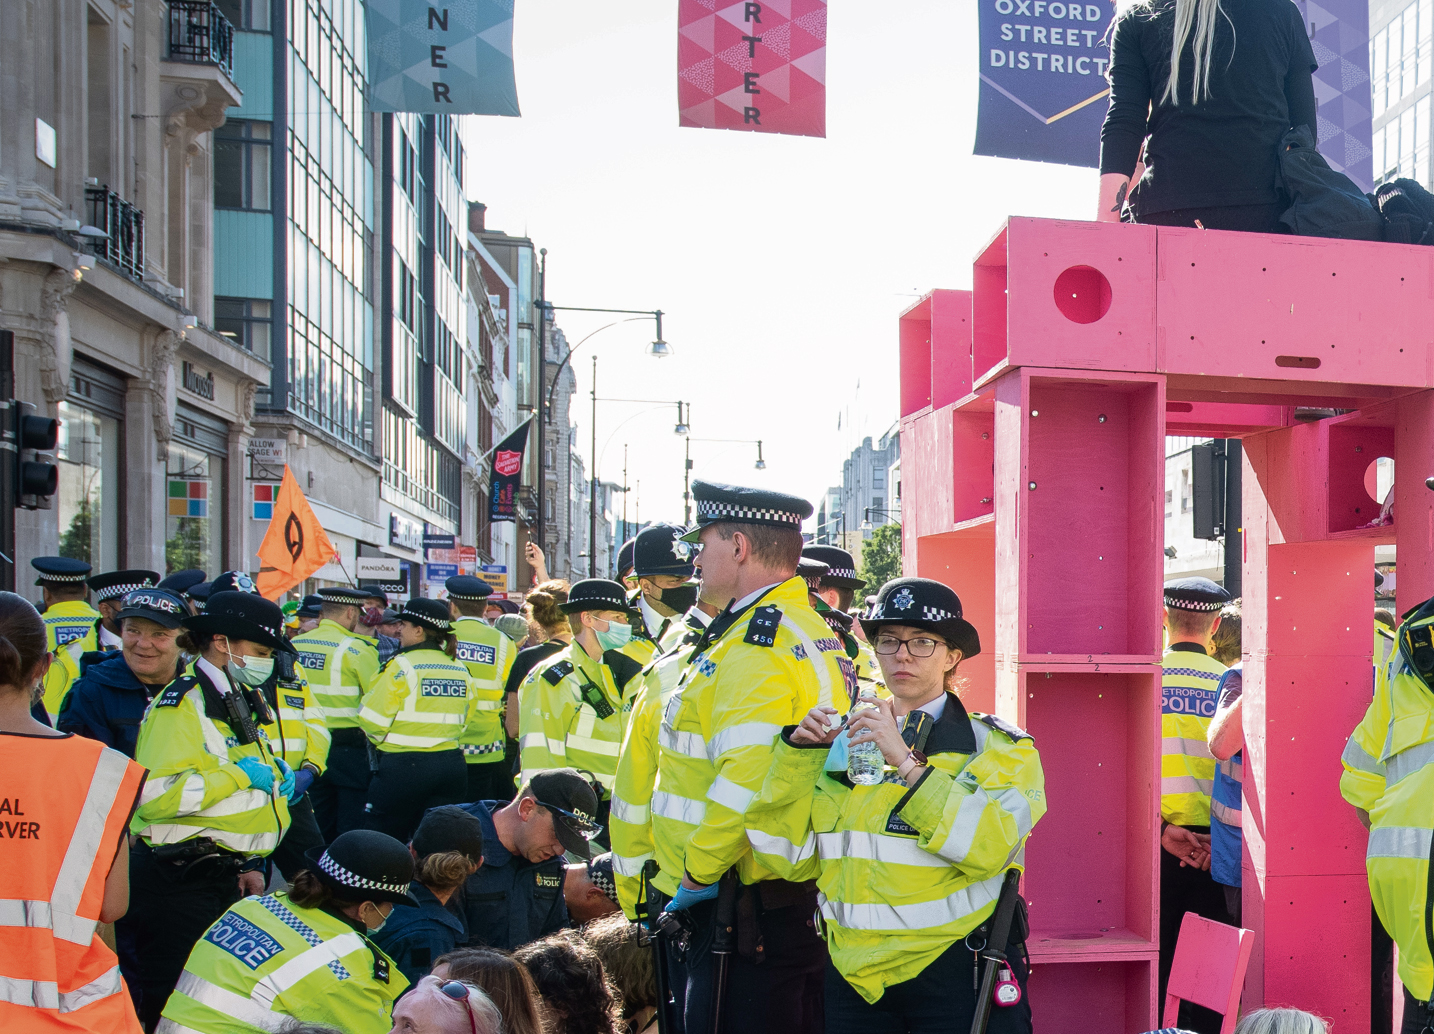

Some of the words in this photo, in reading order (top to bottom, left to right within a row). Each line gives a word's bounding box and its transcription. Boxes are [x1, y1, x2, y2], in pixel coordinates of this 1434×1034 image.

[994, 0, 1101, 22] OXFORD
[1000, 24, 1098, 49] STREET
[990, 49, 1110, 77] DISTRICT
[183, 361, 214, 401] Microsoft
[248, 440, 275, 449] ALLOW
[133, 595, 175, 614] POLICE
[756, 619, 772, 627] CE
[58, 633, 87, 644] POL
[752, 634, 773, 645] 450
[458, 641, 494, 653] ETROPOLITAN
[300, 658, 324, 670] LICE
[422, 684, 467, 698] POLICE
[1162, 688, 1217, 700] ETROPOLIT
[1162, 696, 1216, 716] OLIC
[888, 823, 909, 832] POLICE
[543, 880, 561, 888] POLIC
